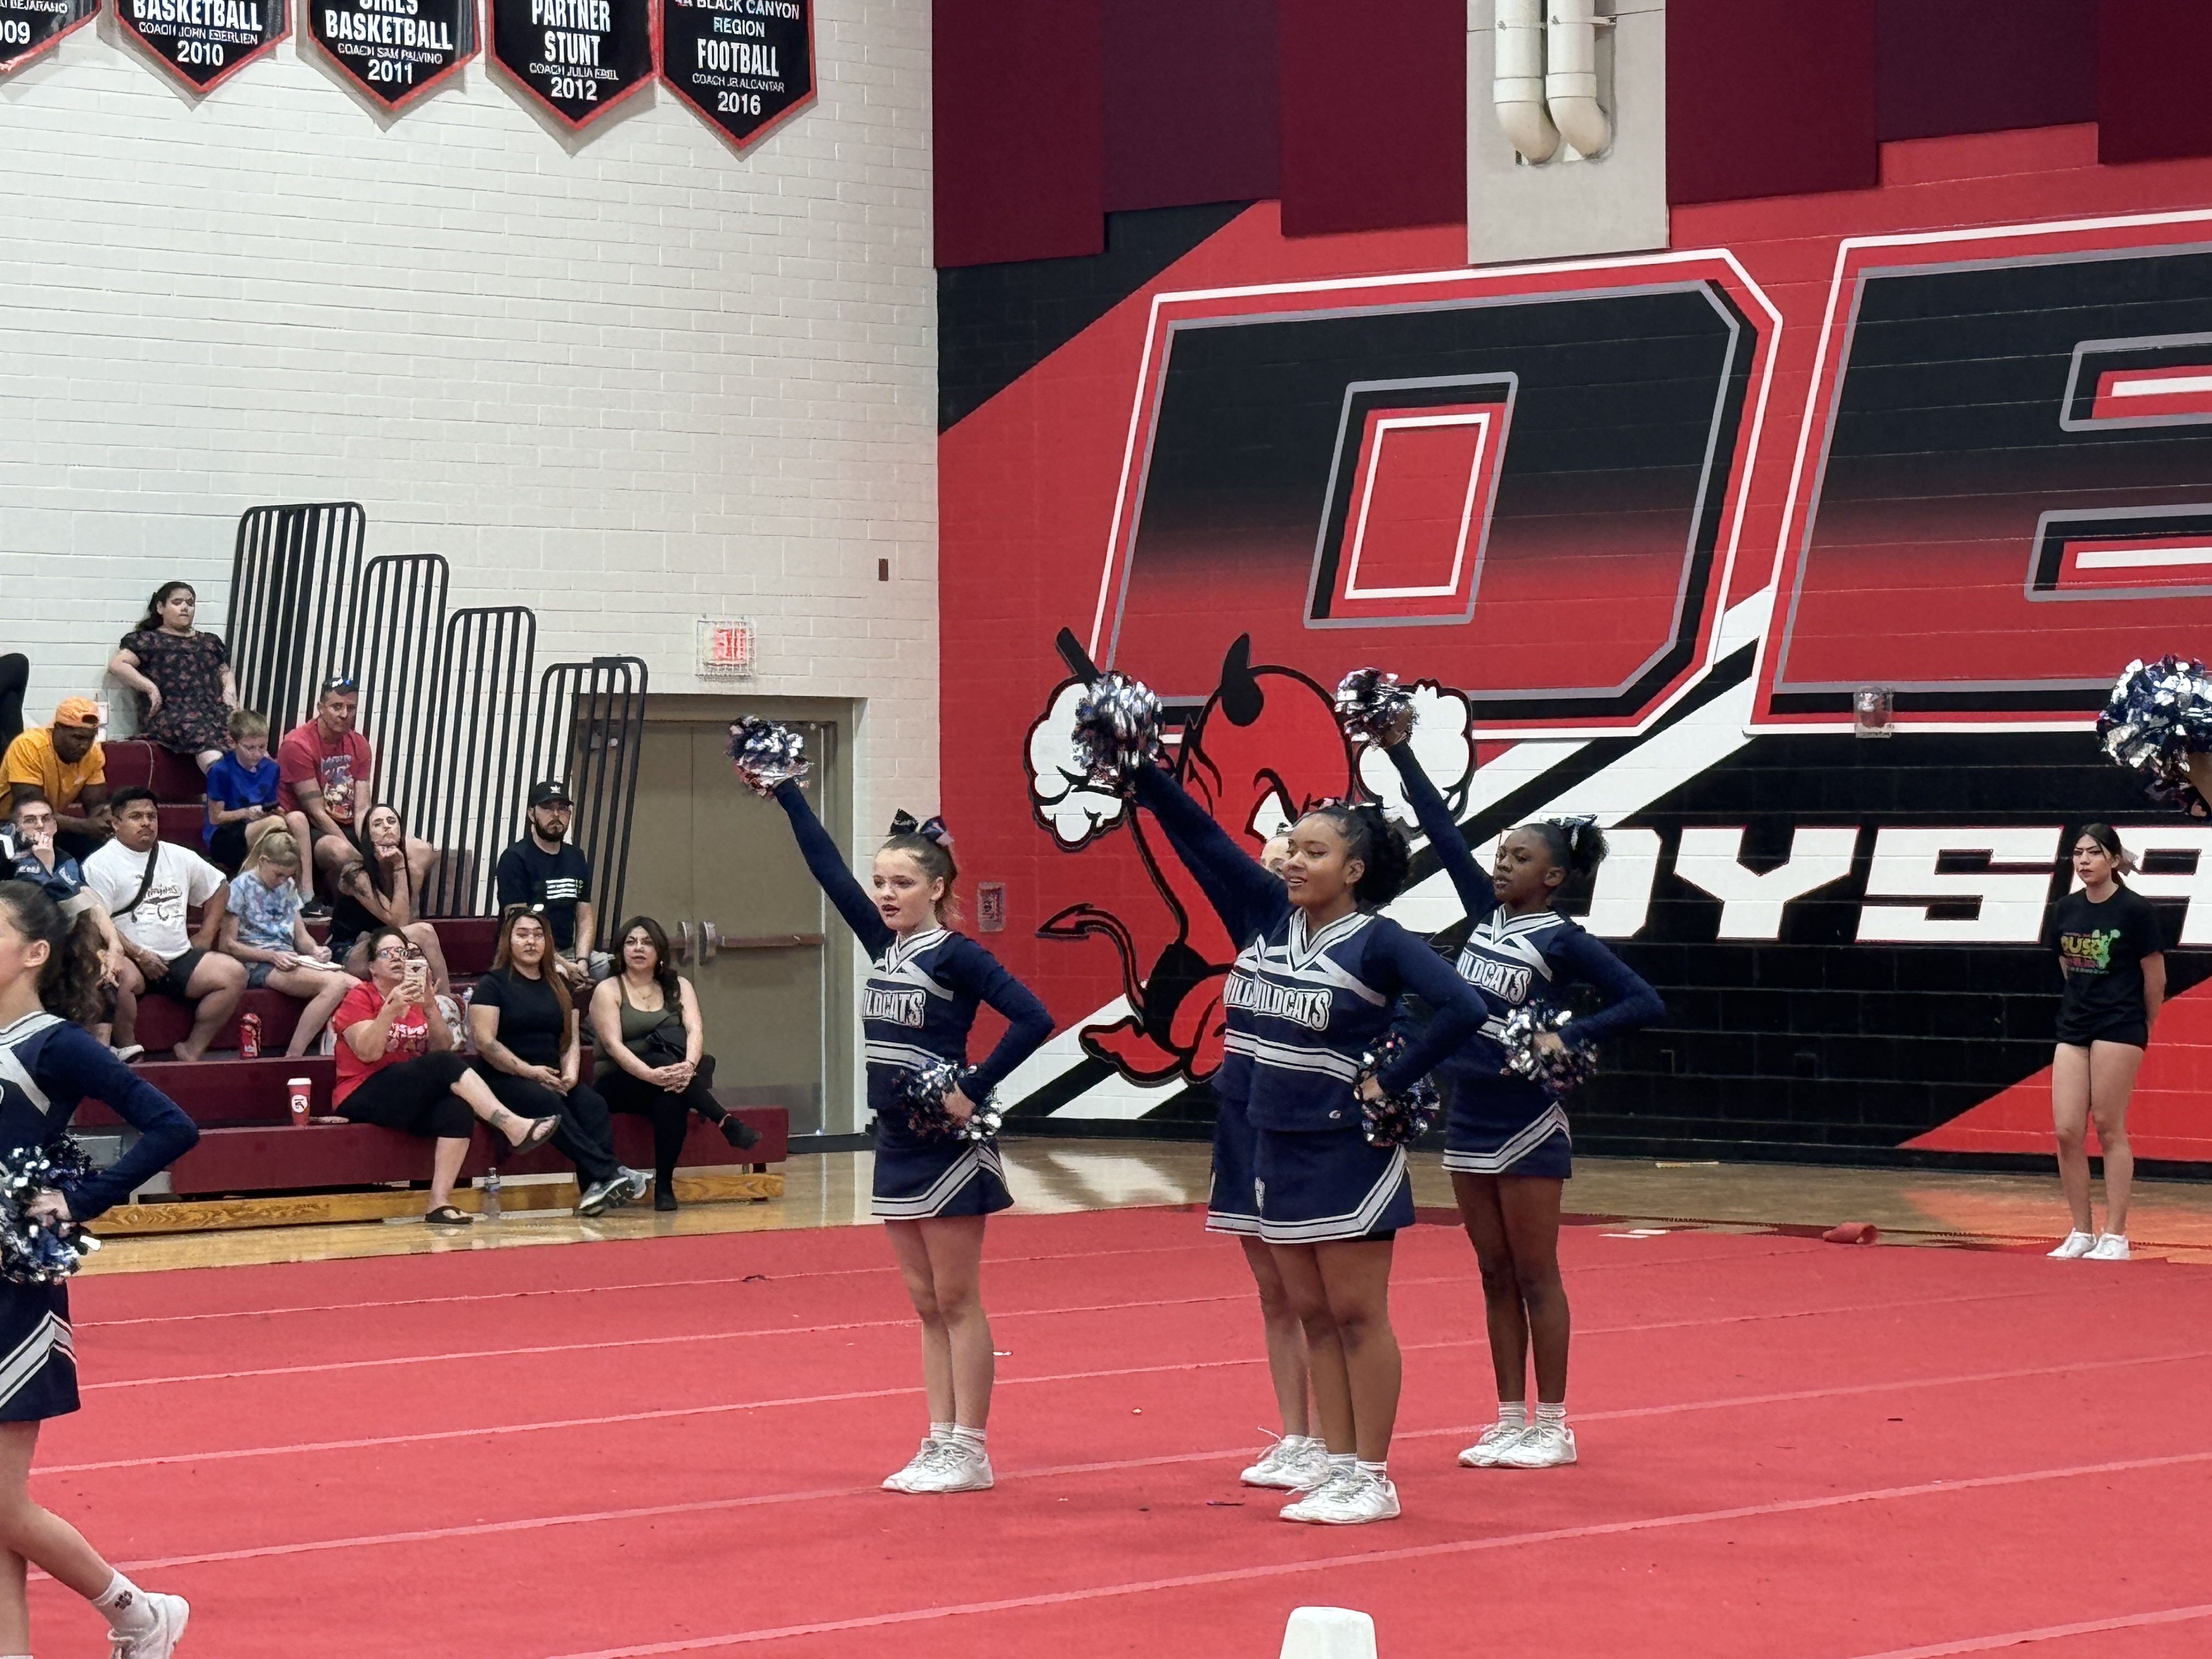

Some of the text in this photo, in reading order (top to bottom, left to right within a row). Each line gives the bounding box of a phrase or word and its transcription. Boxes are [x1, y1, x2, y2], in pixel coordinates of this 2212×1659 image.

[133, 0, 262, 31] BASKETBALL
[532, 0, 611, 32] PARTNER
[746, 0, 800, 20] CANYON
[138, 21, 176, 36] COACH
[178, 26, 206, 40] JOHN
[325, 9, 453, 50] BASKETBALL
[713, 16, 765, 37] REGION
[177, 40, 224, 66] 2010
[337, 43, 374, 56] COACH
[544, 30, 601, 66] STUNT
[697, 38, 780, 77] FOOTBALL
[368, 59, 413, 84] 2011
[529, 63, 565, 76] COACH
[692, 72, 726, 87] COACH
[551, 77, 598, 101] 2012
[718, 91, 761, 115] 2016
[863, 988, 926, 1028] ILDCATS
